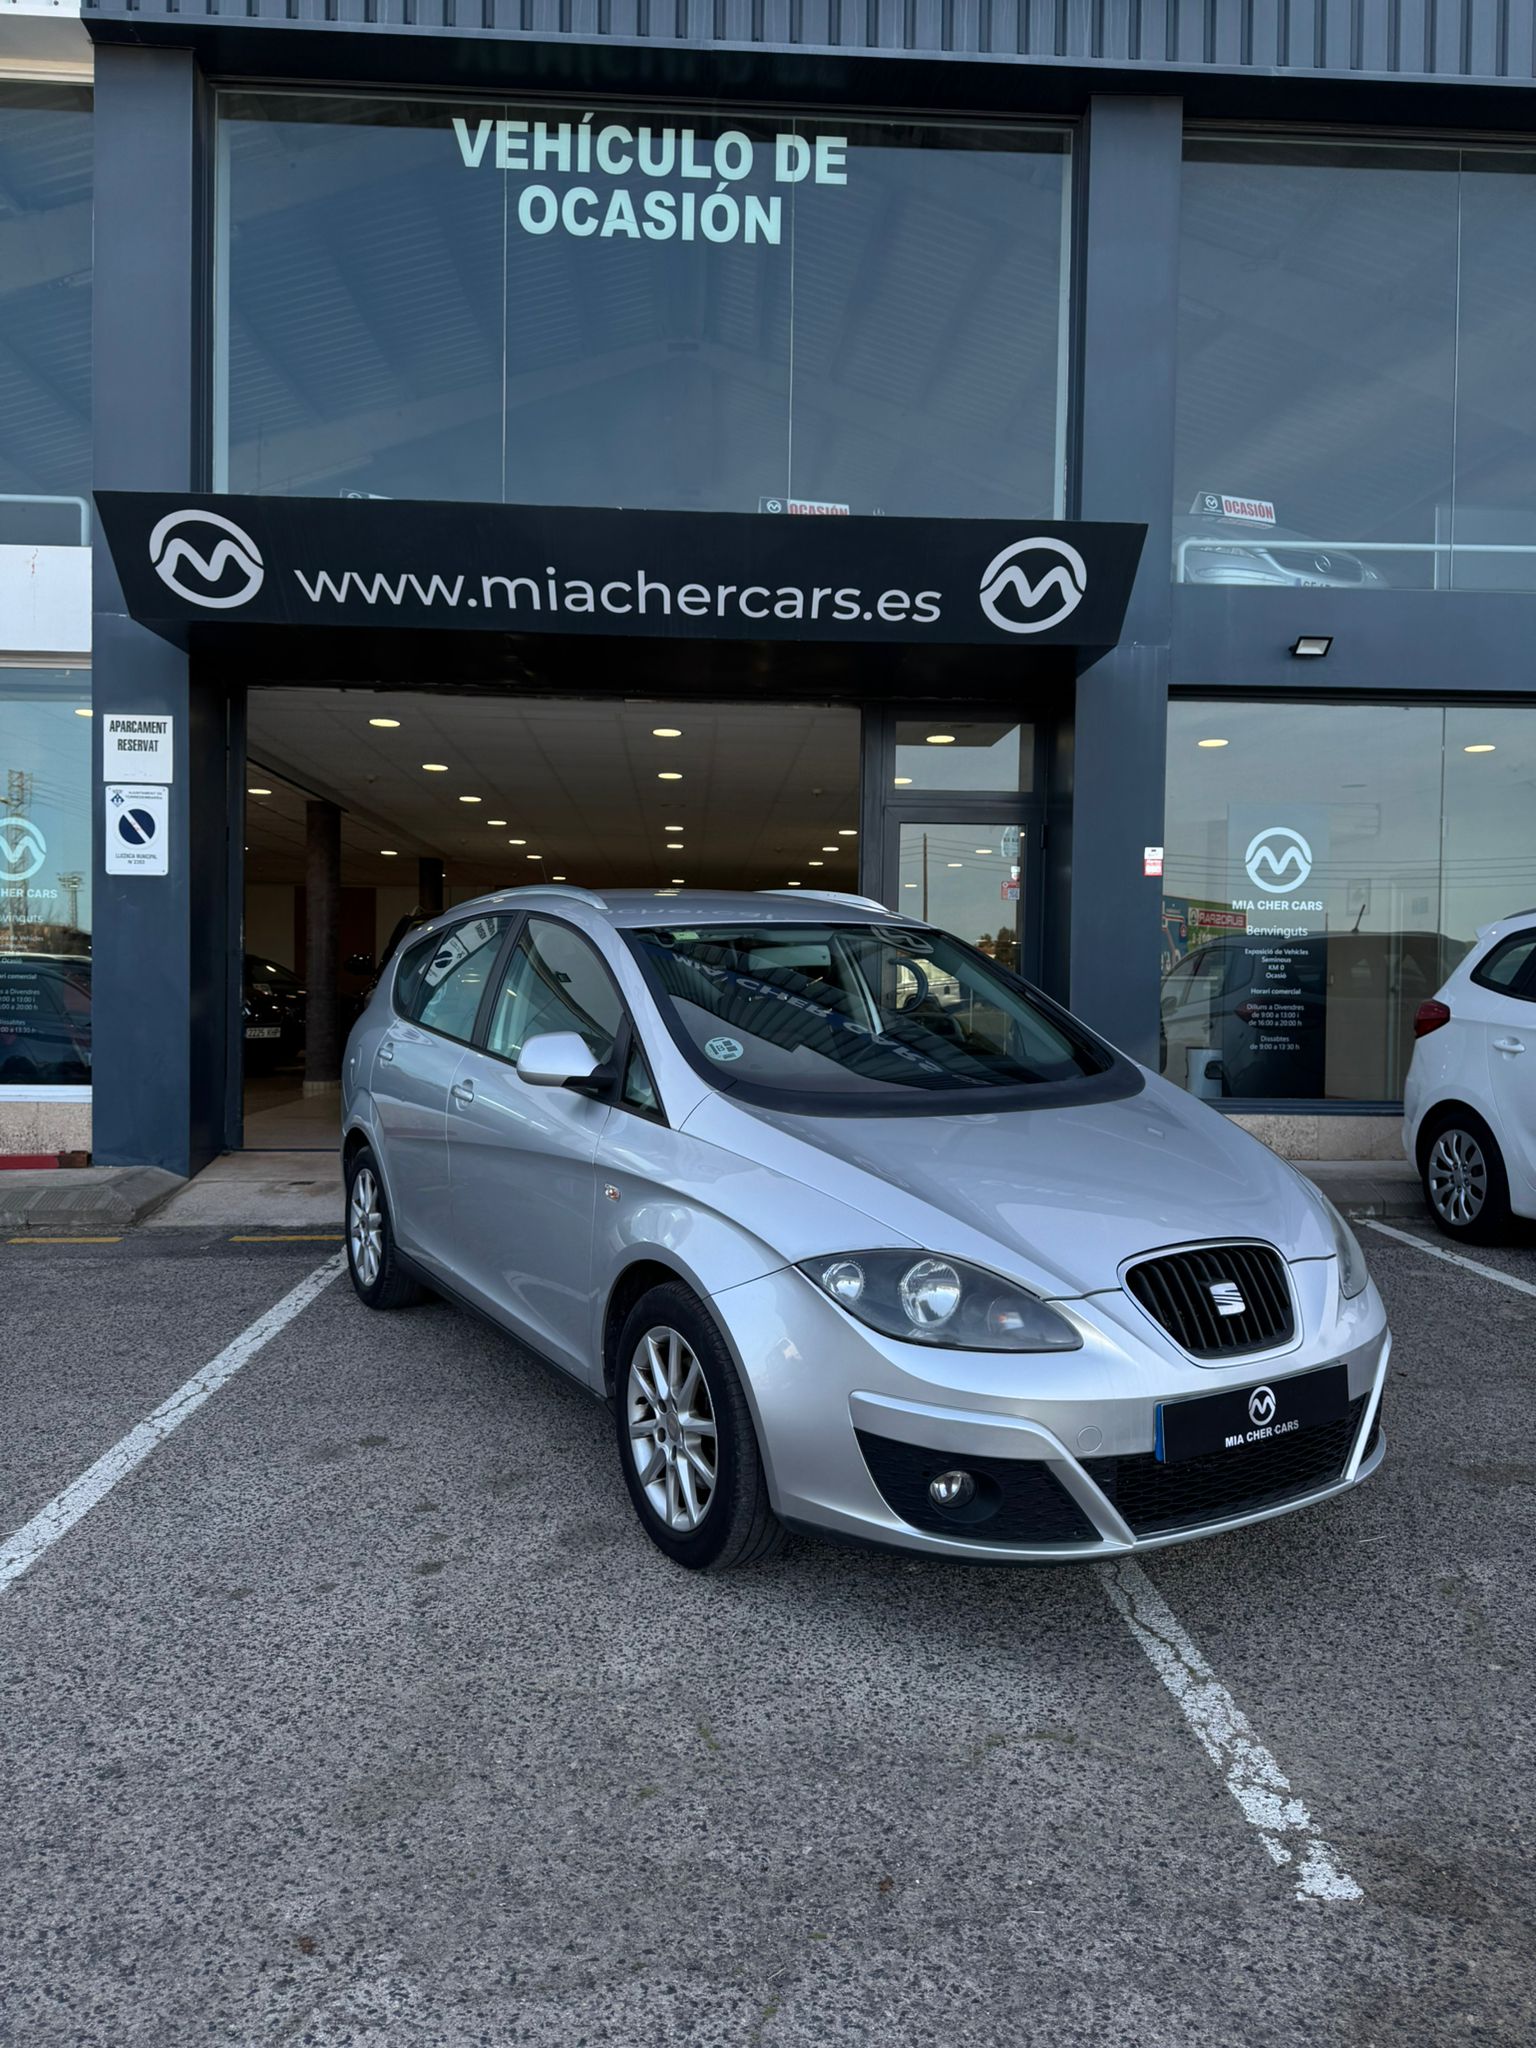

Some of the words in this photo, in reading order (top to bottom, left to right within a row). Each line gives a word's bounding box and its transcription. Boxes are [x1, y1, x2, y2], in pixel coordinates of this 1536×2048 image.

[452, 112, 753, 181] VEHÍCULO
[775, 133, 848, 185] DE
[518, 182, 782, 245] OCASIÓN
[1224, 499, 1274, 519] OCASIÓN
[294, 566, 943, 623] www.miachercars.es
[109, 720, 168, 734] APARCAMENT
[117, 739, 159, 752] RESERVAT
[0, 888, 24, 898] HER
[27, 889, 58, 899] CARS
[1231, 900, 1255, 910] MIA
[1257, 900, 1289, 911] CHER
[1291, 901, 1323, 911] CARS
[0, 911, 44, 925] vinguts
[1246, 924, 1309, 939] Benvinguts
[1244, 948, 1273, 956] Exposició
[1265, 971, 1287, 979] Ocasió
[1250, 987, 1270, 995] Horari
[1271, 987, 1301, 995] comercial
[1246, 1003, 1267, 1011] Dilluns
[1225, 1435, 1244, 1448] MIA
[1246, 1427, 1273, 1442] CHER
[1274, 1419, 1300, 1434] CARS
